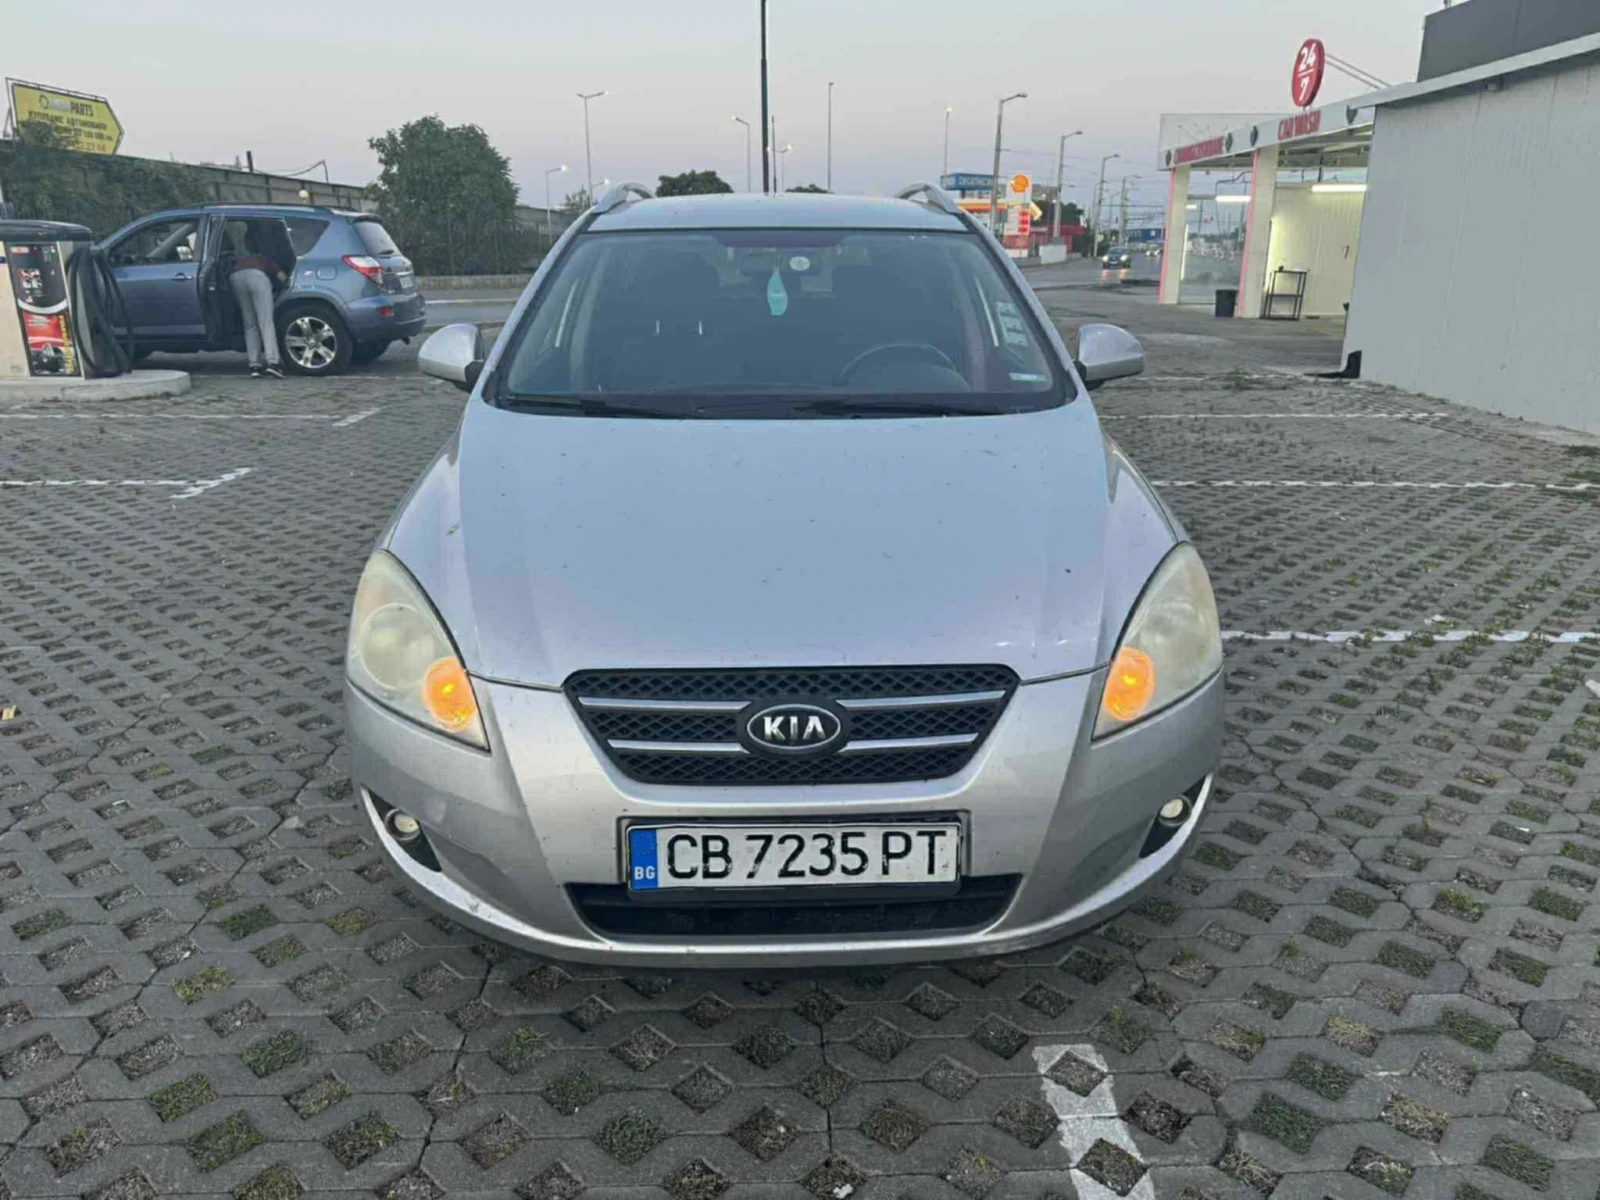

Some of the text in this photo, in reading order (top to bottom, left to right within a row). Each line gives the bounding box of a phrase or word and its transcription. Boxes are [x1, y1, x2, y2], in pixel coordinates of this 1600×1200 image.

[1298, 43, 1316, 72] 24
[1300, 75, 1310, 102] 7
[69, 100, 94, 117] PARTS
[1277, 109, 1322, 141] CAR WASH
[763, 715, 826, 740] KIA
[667, 830, 947, 880] CB 7235 PT
[634, 865, 656, 880] BG
